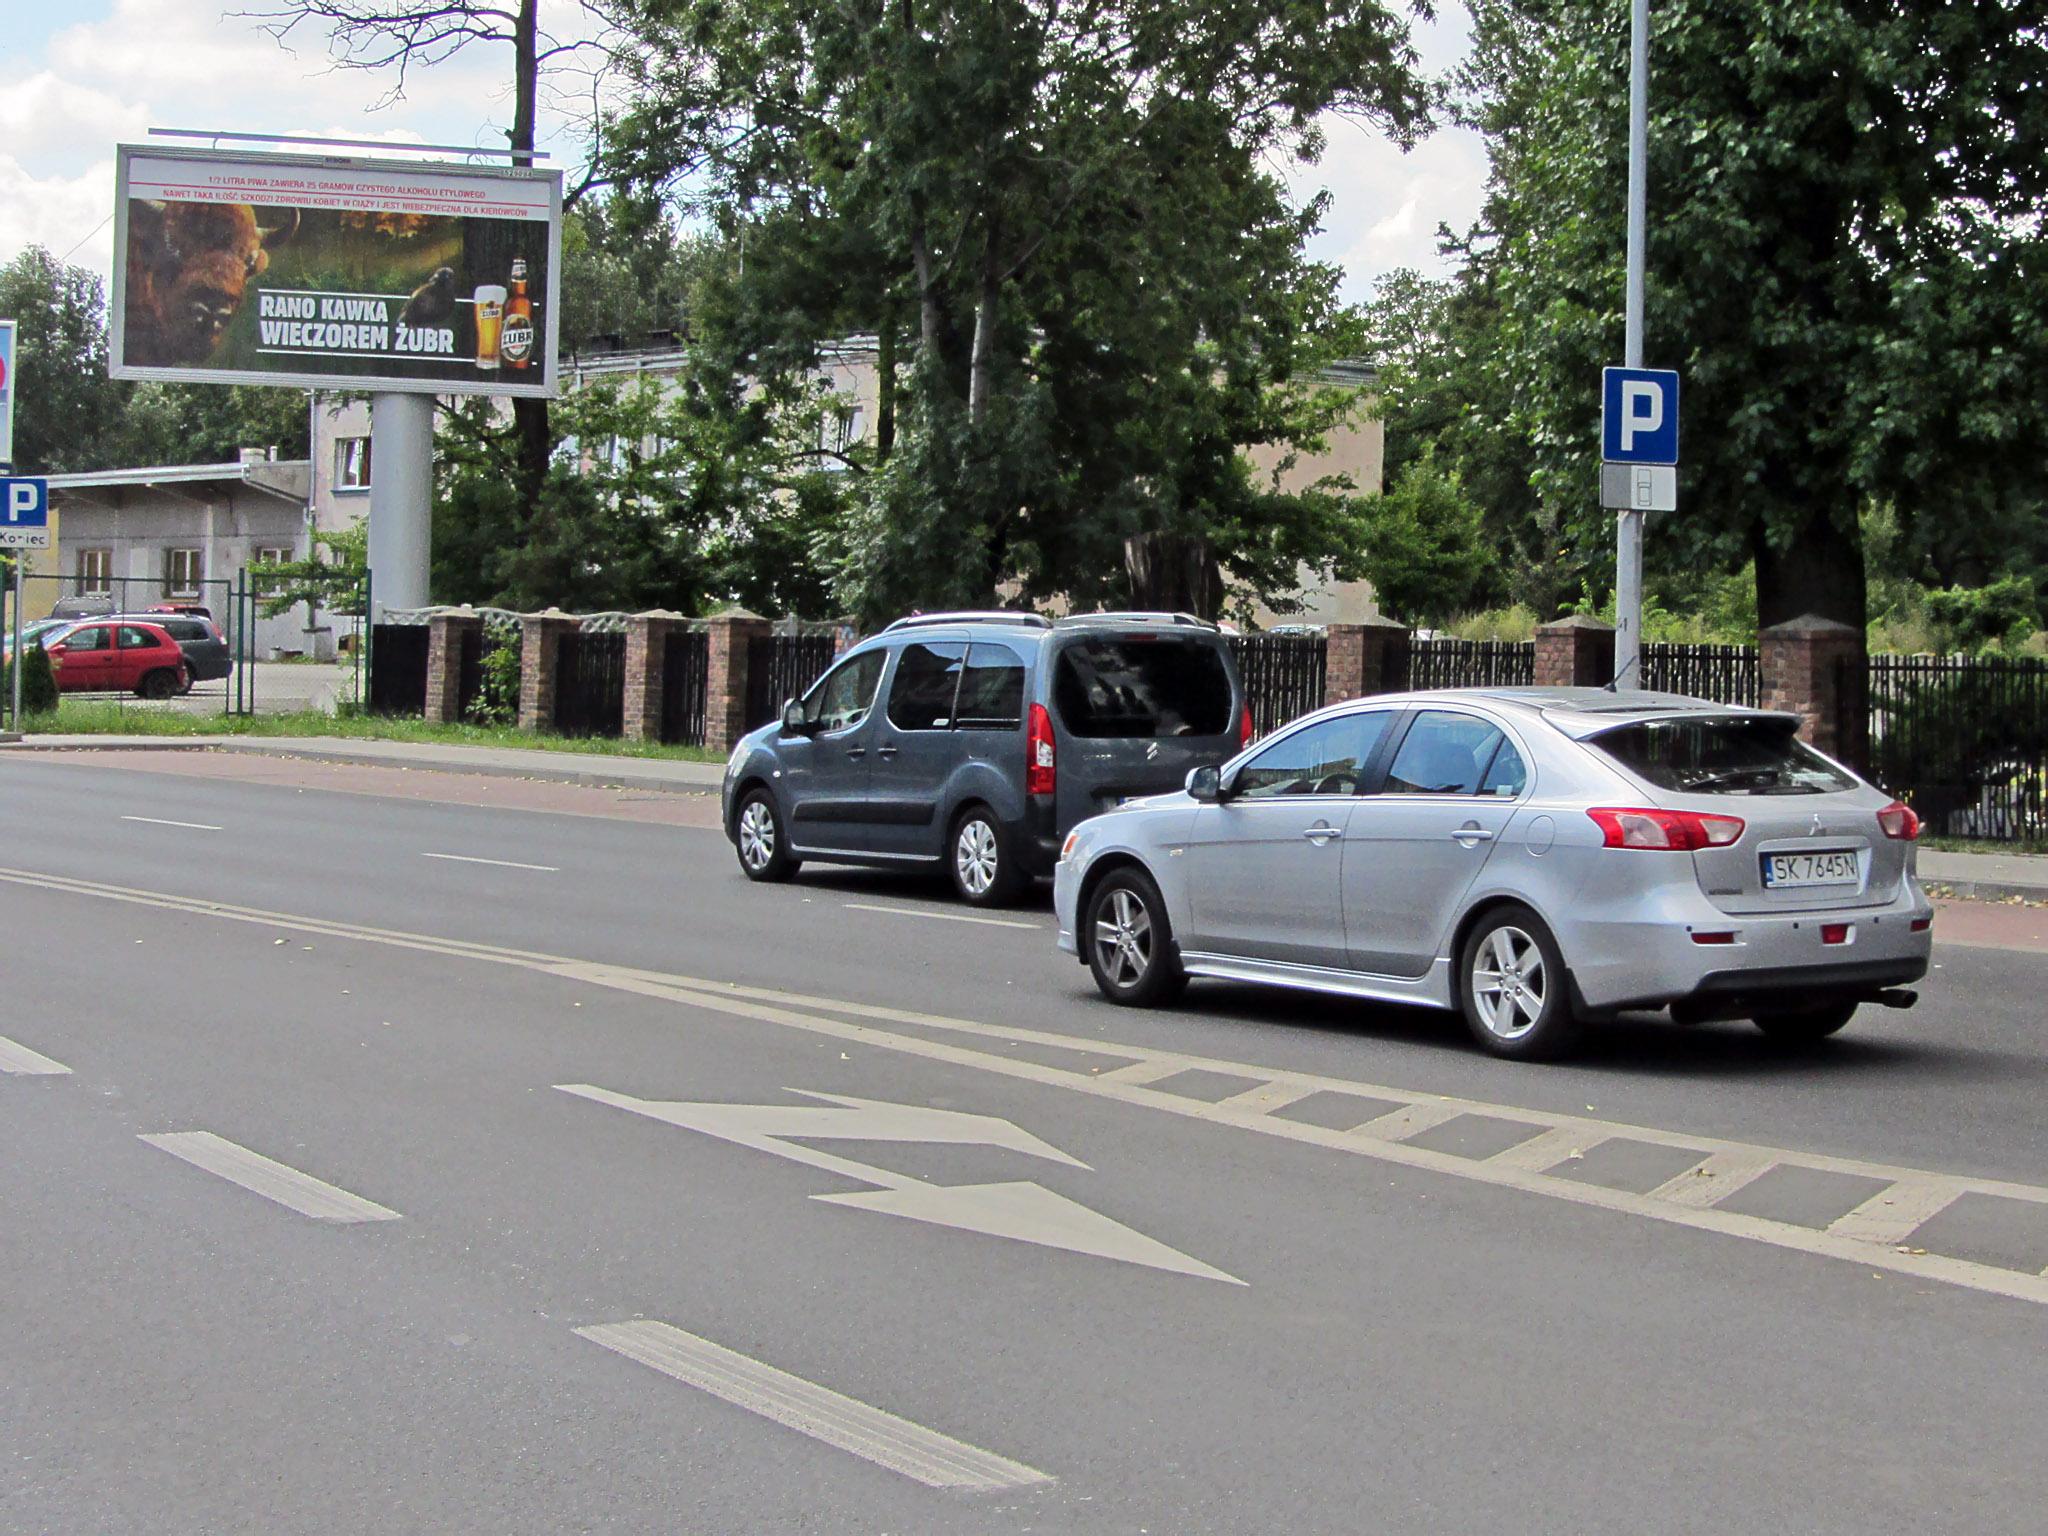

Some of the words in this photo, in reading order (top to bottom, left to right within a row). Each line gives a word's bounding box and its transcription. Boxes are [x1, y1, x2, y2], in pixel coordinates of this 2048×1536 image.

[163, 189, 190, 198] NAWET
[194, 190, 213, 199] TAKA
[240, 193, 274, 203] SZKODZI
[275, 194, 310, 205] ZDROWIU
[313, 197, 340, 207] KOBIET
[343, 199, 351, 207] W
[382, 201, 401, 210] JEST
[402, 202, 461, 214] NIEBEZPIECZNA
[464, 205, 479, 214] DLA
[223, 176, 246, 186] LITRA
[247, 177, 268, 187] PIWA
[270, 178, 304, 188] ZAWIERA
[356, 183, 395, 194] CZYSTEGO
[398, 185, 438, 196] ALKOHOLU
[440, 188, 486, 199] ETYLOWEGO
[260, 295, 316, 319] RANO
[321, 298, 389, 323] KAWKA
[260, 320, 389, 350] WIECZOREM
[394, 322, 454, 354] ŻUBR
[1621, 380, 1663, 451] P
[9, 483, 38, 521] P
[1775, 857, 1800, 880] SK
[1804, 854, 1856, 880] 7645N
